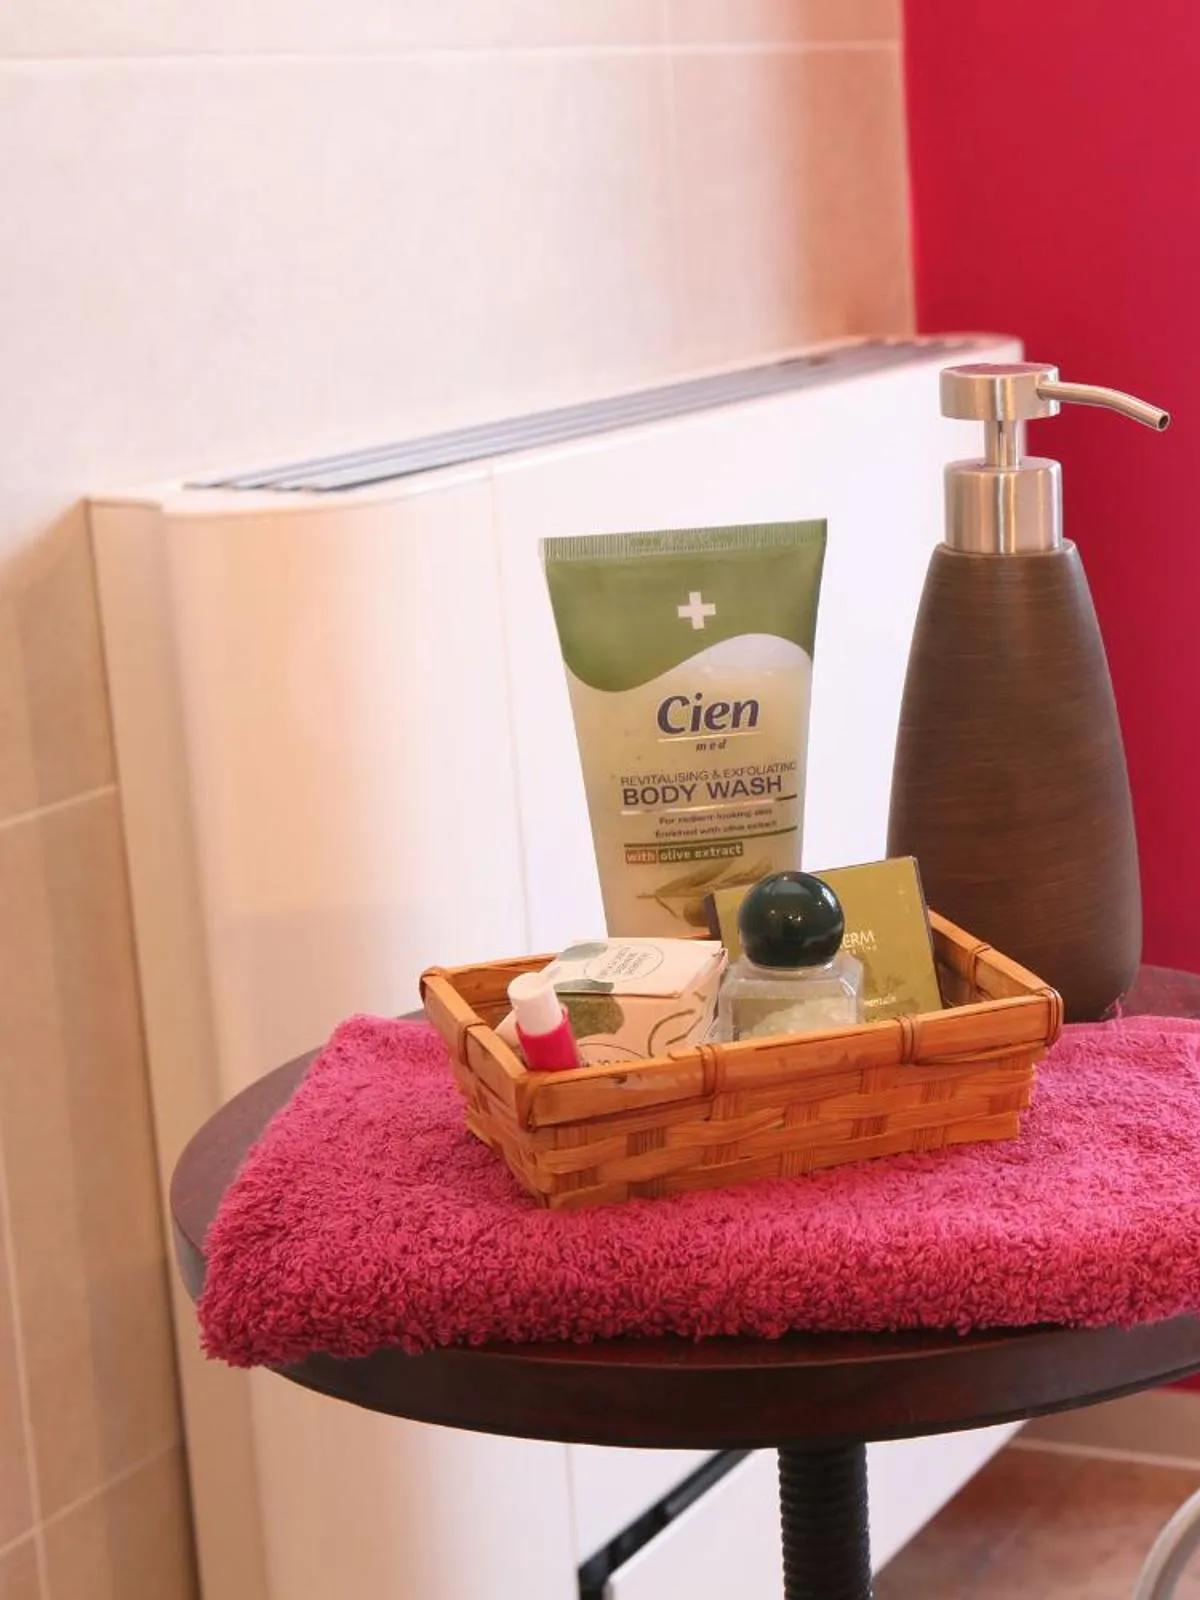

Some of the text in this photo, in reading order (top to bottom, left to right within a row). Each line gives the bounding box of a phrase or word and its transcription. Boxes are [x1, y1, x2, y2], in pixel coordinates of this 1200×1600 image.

[657, 692, 759, 734] Cien
[696, 739, 727, 752] med
[620, 769, 710, 786] REVITALISING
[711, 768, 721, 780] &
[623, 775, 782, 806] BODY WASH
[700, 825, 720, 835] with
[626, 844, 742, 862] with olive extract
